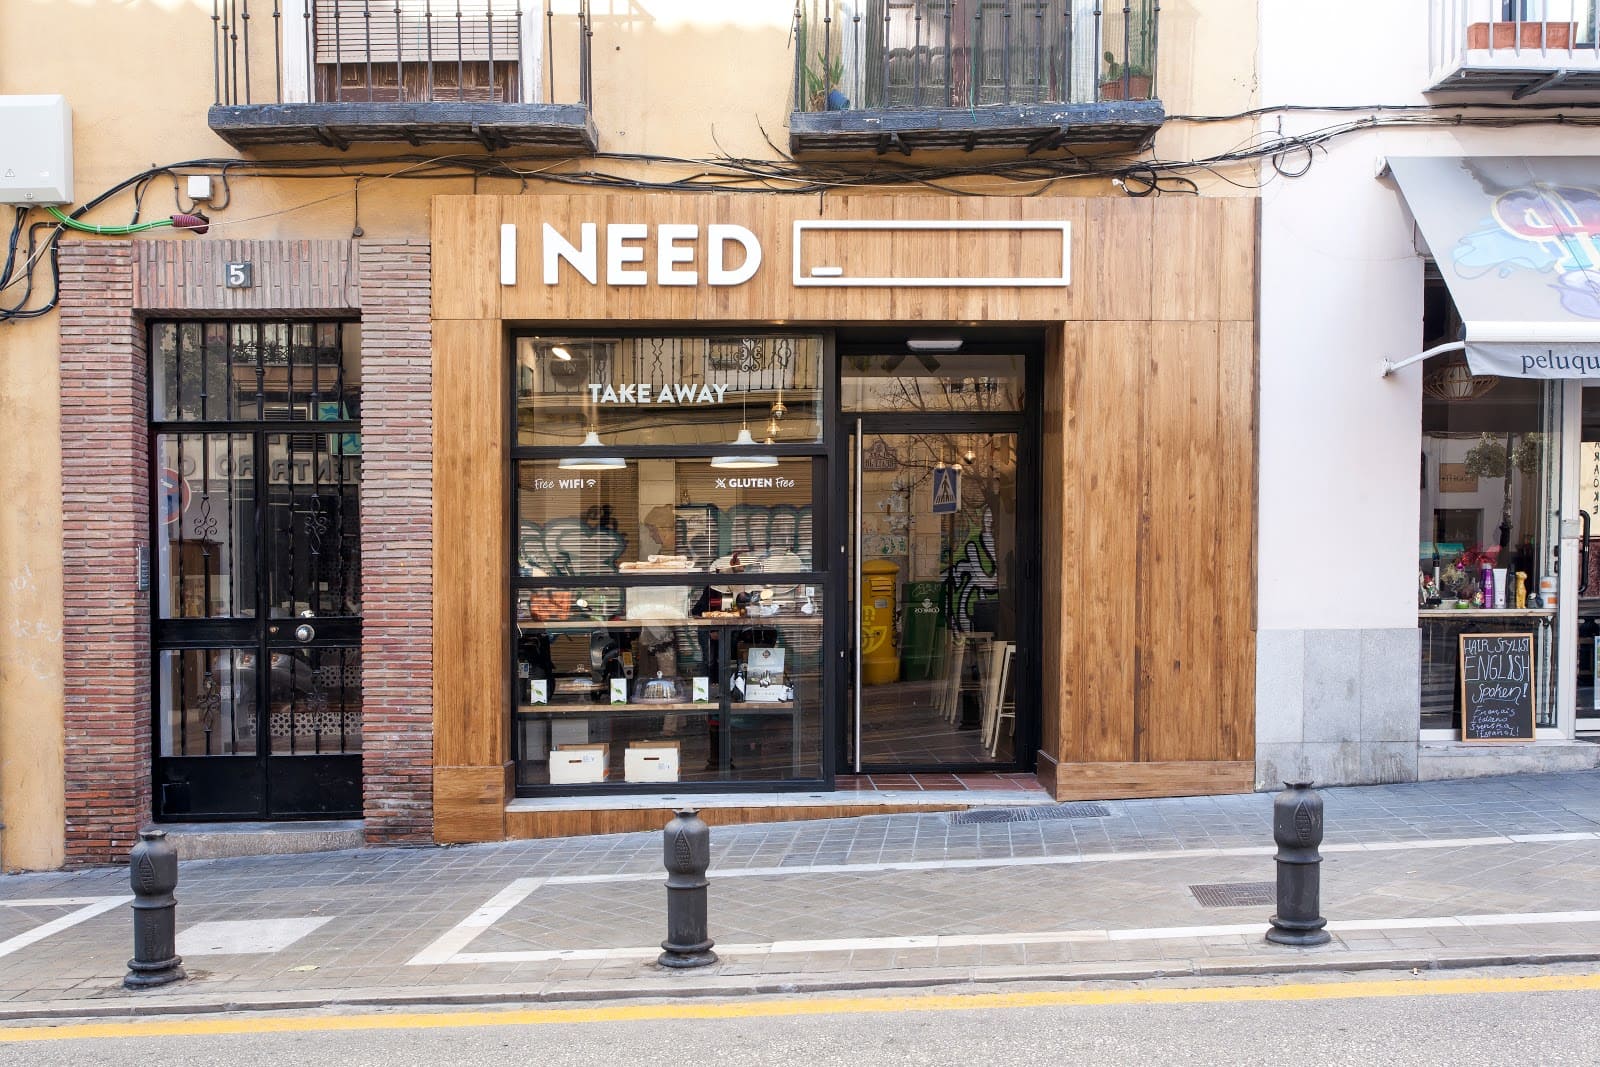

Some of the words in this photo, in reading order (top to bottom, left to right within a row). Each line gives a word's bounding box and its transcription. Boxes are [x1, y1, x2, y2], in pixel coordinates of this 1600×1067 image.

[501, 223, 516, 285] I
[543, 222, 762, 285] NEED
[230, 264, 245, 285] 5
[1520, 349, 1600, 375] peluqu
[588, 383, 651, 404] TAKE
[657, 383, 729, 404] AWAY
[534, 478, 555, 489] Free
[559, 479, 584, 489] WIFI
[728, 478, 773, 488] GLUTEN
[775, 477, 795, 489] Free
[1463, 639, 1494, 655] HAIR
[1495, 637, 1530, 654] STYLIST
[1463, 655, 1530, 682] ENGLISH
